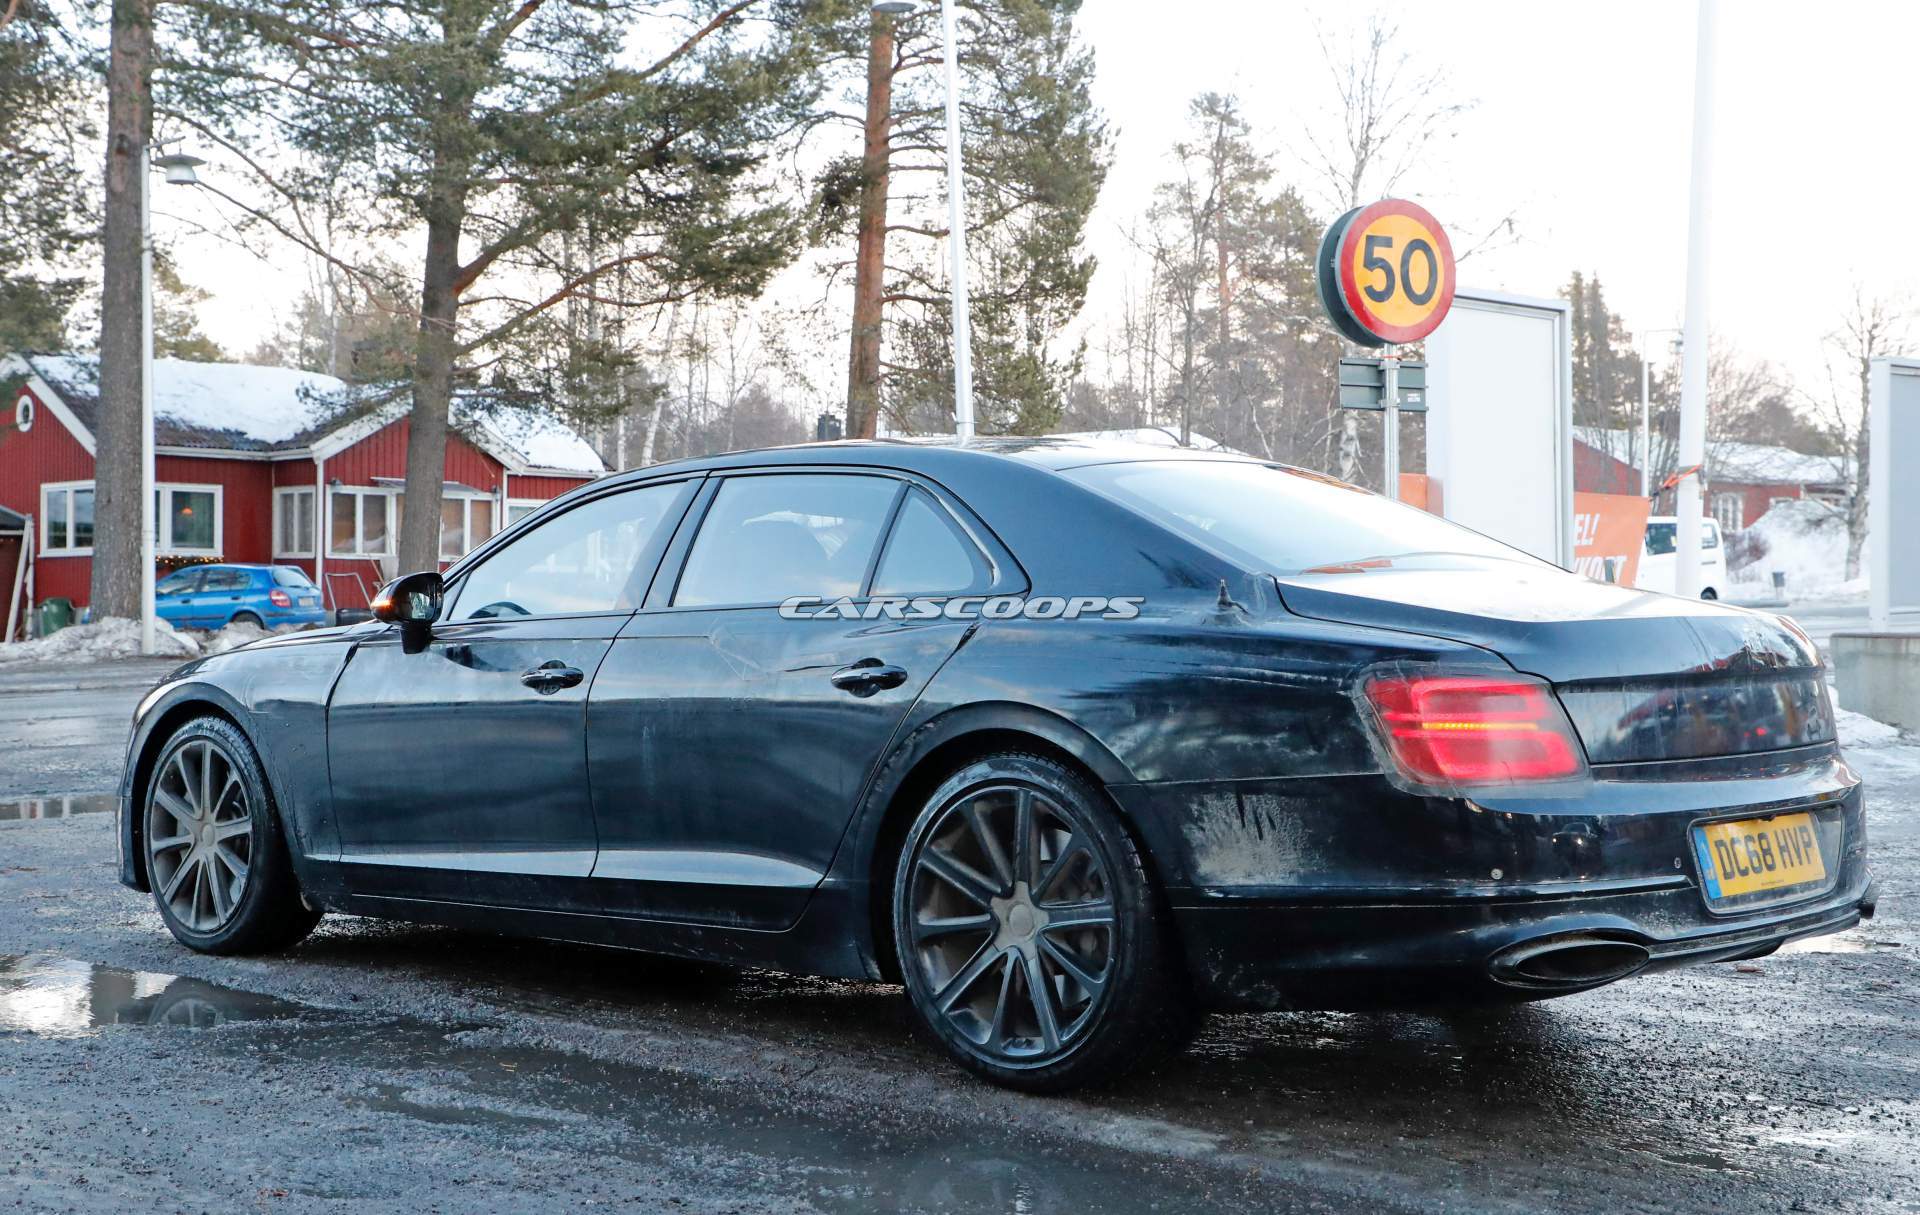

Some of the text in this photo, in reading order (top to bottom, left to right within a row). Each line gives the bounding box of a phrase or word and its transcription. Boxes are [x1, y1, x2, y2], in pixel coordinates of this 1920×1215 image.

[1363, 234, 1438, 305] 50
[1715, 832, 1776, 880] DC68
[1775, 825, 1812, 868] HVP
